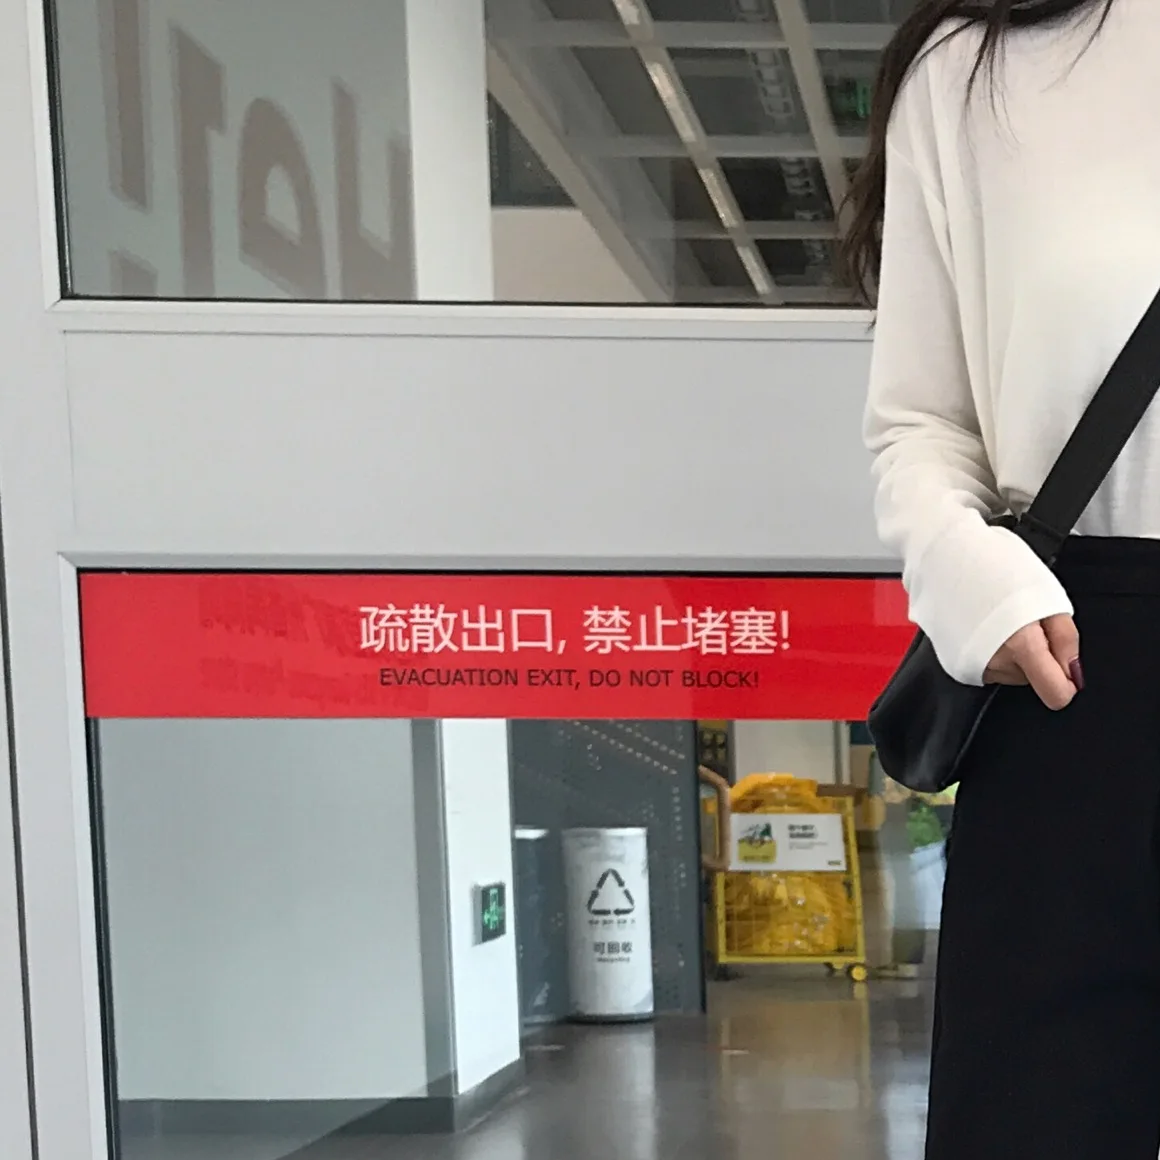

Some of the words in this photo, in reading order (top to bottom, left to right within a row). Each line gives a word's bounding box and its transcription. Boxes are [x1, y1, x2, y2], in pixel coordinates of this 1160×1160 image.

[583, 605, 790, 655] 禁止堵塞!
[379, 668, 518, 686] EVACUATION
[527, 668, 581, 690] EXIT,
[589, 669, 622, 687] DO
[629, 669, 674, 688] NOT
[682, 670, 759, 688] BLOCK!
